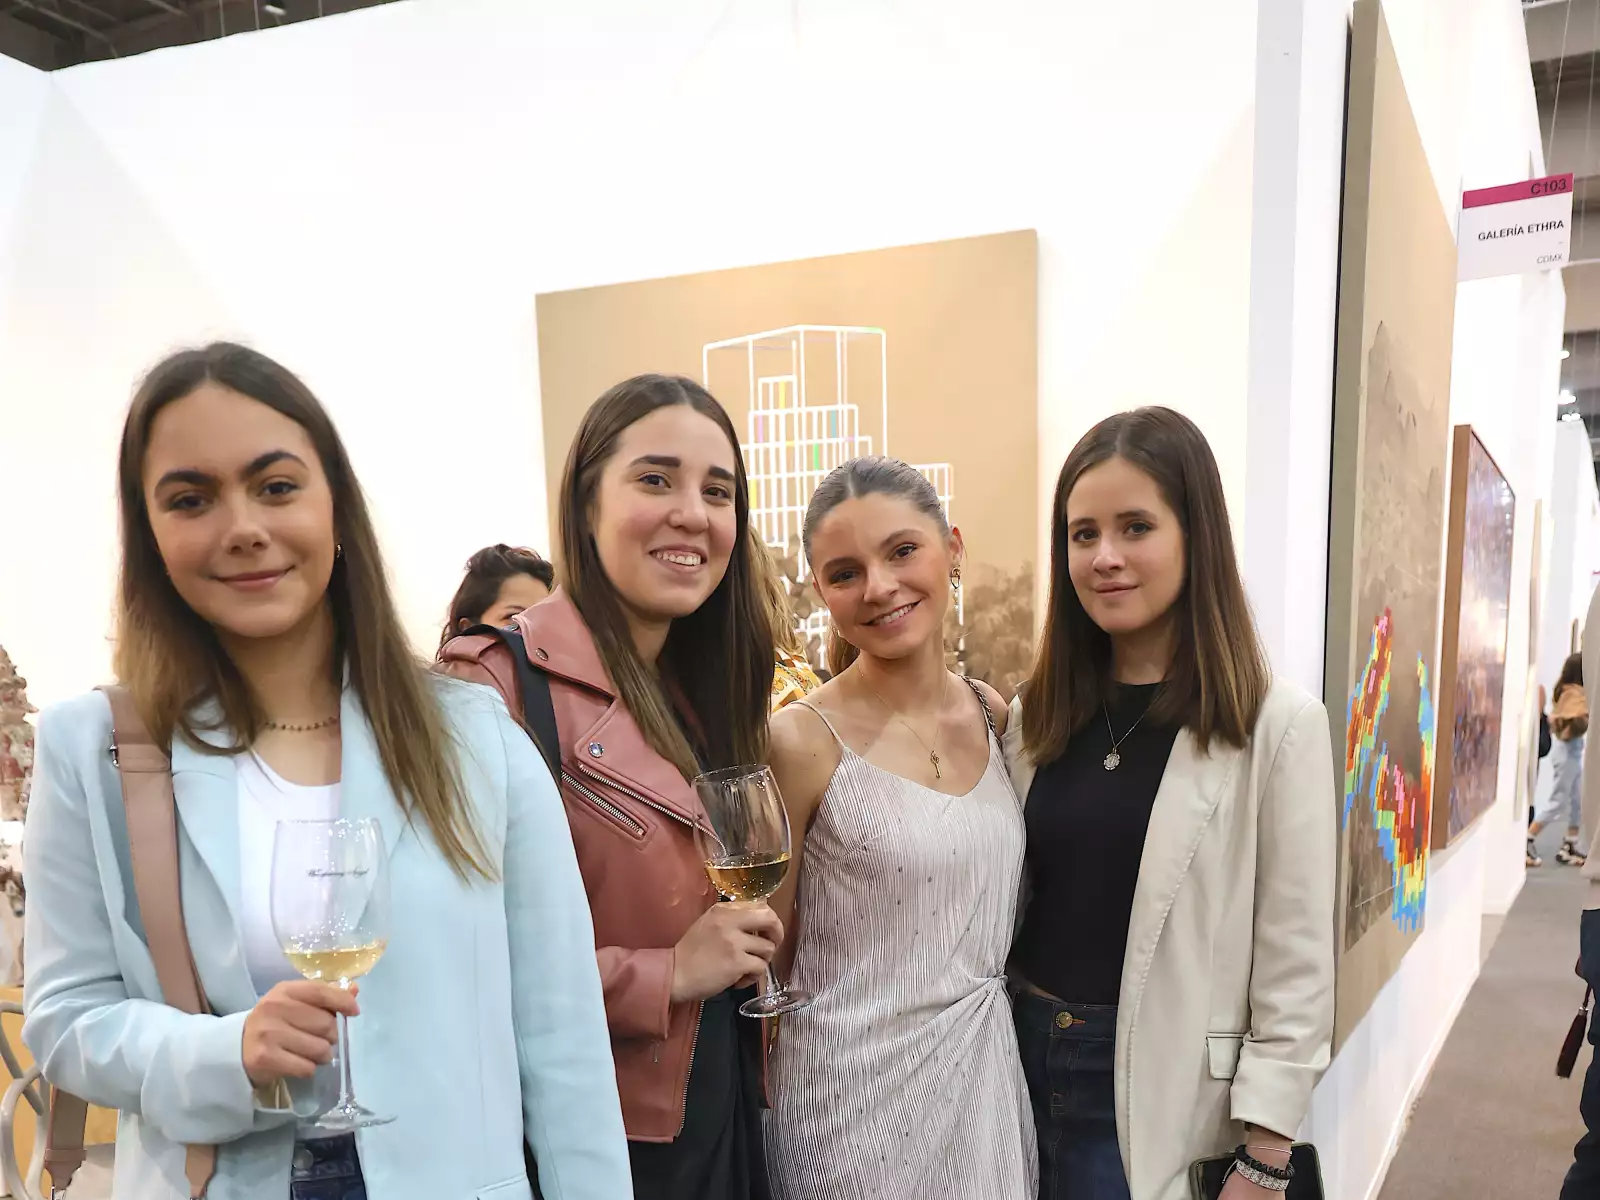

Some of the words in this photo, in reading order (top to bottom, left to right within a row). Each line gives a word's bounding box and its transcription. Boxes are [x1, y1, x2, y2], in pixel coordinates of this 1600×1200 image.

[1530, 178, 1567, 195] C103
[1478, 224, 1524, 241] GALERÍA
[1528, 220, 1564, 234] ETHRA
[1536, 253, 1563, 264] CDMX
